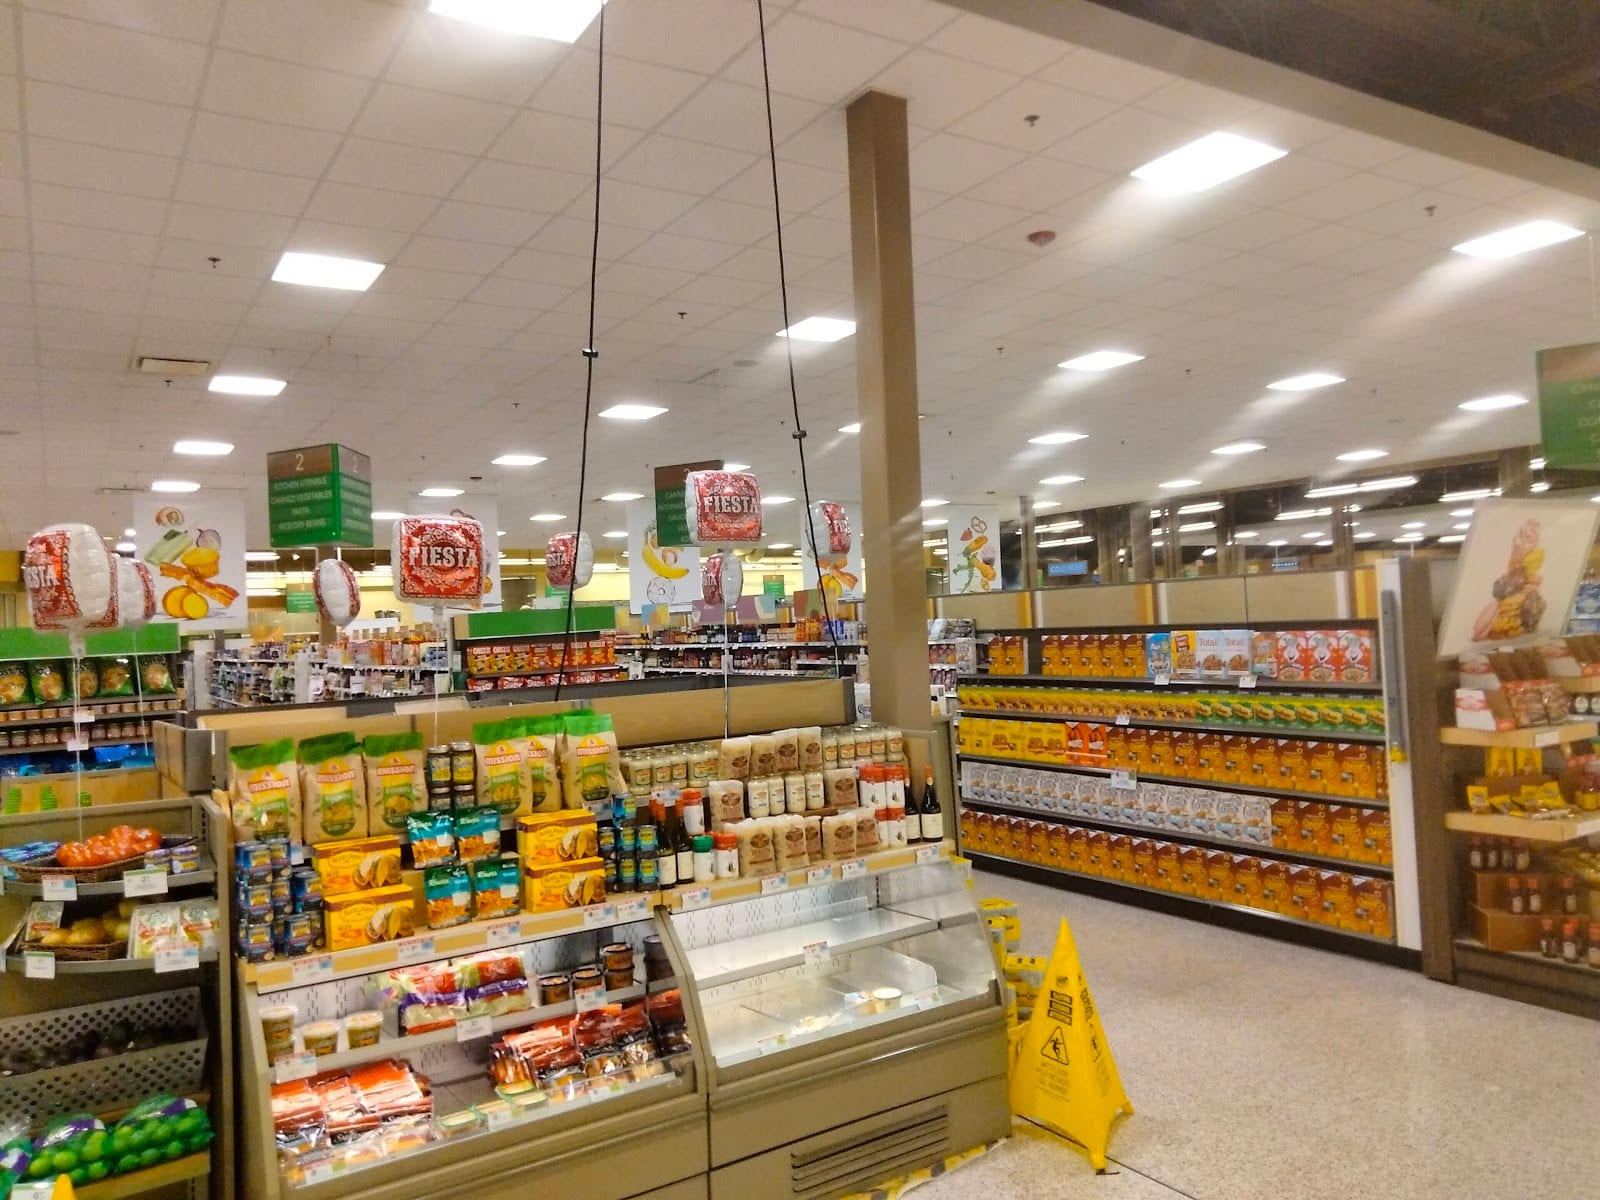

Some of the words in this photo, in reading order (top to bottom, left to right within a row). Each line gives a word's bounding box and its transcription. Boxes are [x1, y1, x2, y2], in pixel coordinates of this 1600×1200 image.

[295, 453, 305, 471] 2
[702, 494, 760, 514] FIESTA
[408, 545, 478, 568] FIESTA
